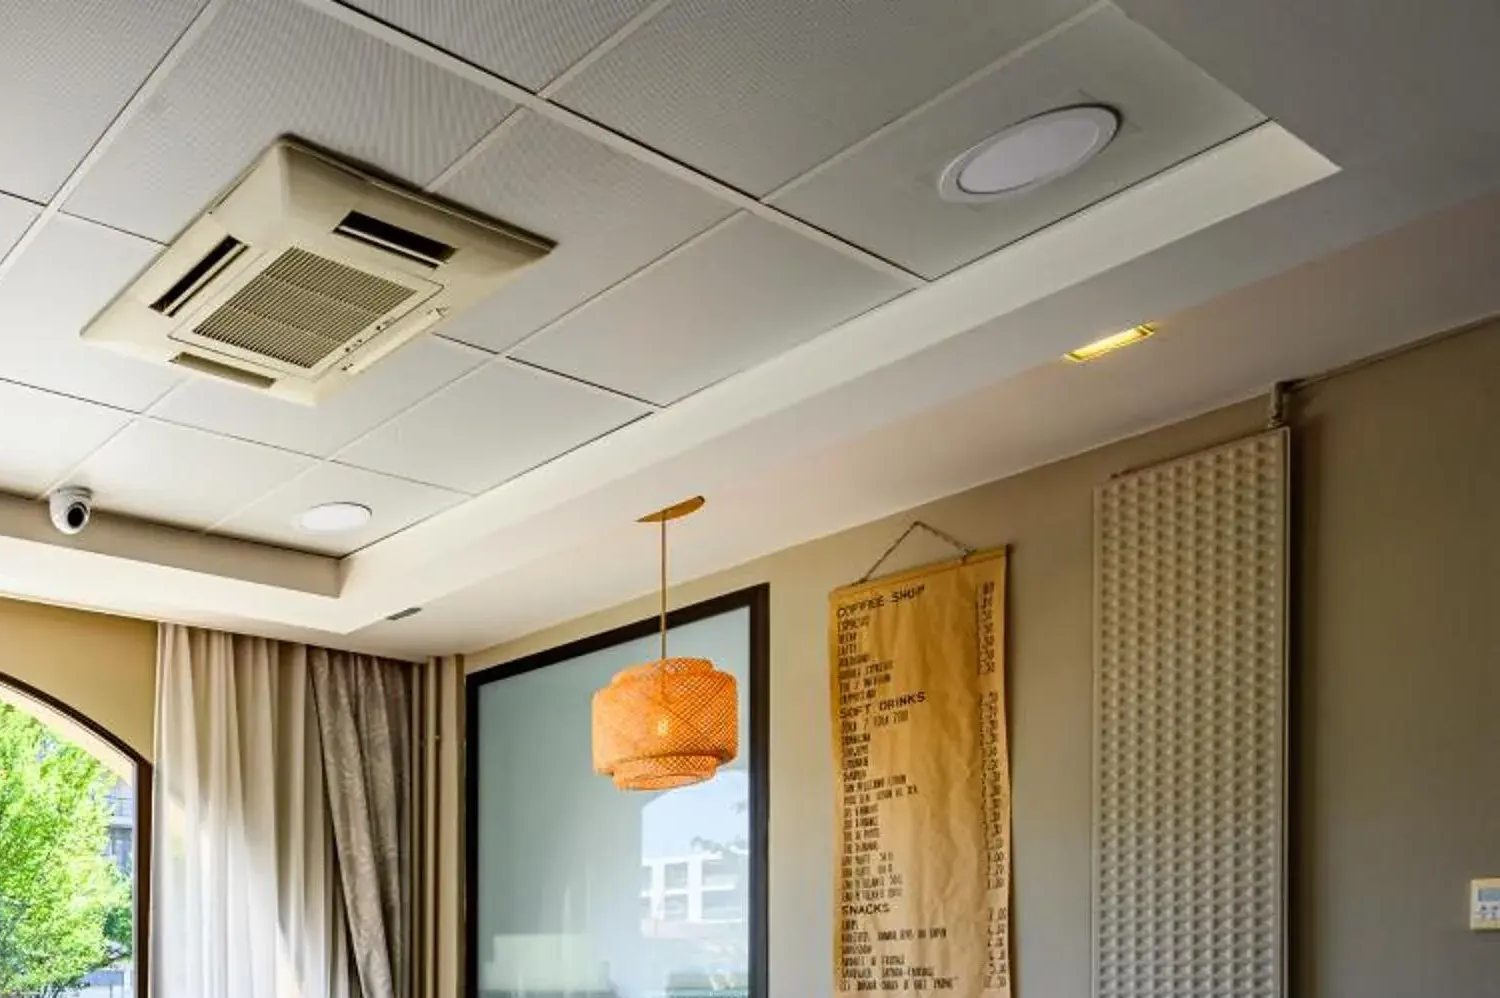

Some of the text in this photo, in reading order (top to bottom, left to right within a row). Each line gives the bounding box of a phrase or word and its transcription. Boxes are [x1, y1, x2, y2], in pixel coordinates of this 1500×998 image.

[836, 584, 925, 617] COFFEE SHOP
[840, 703, 871, 718] SOFT
[880, 691, 926, 711] DRINKS
[842, 903, 891, 914] SNACKS
